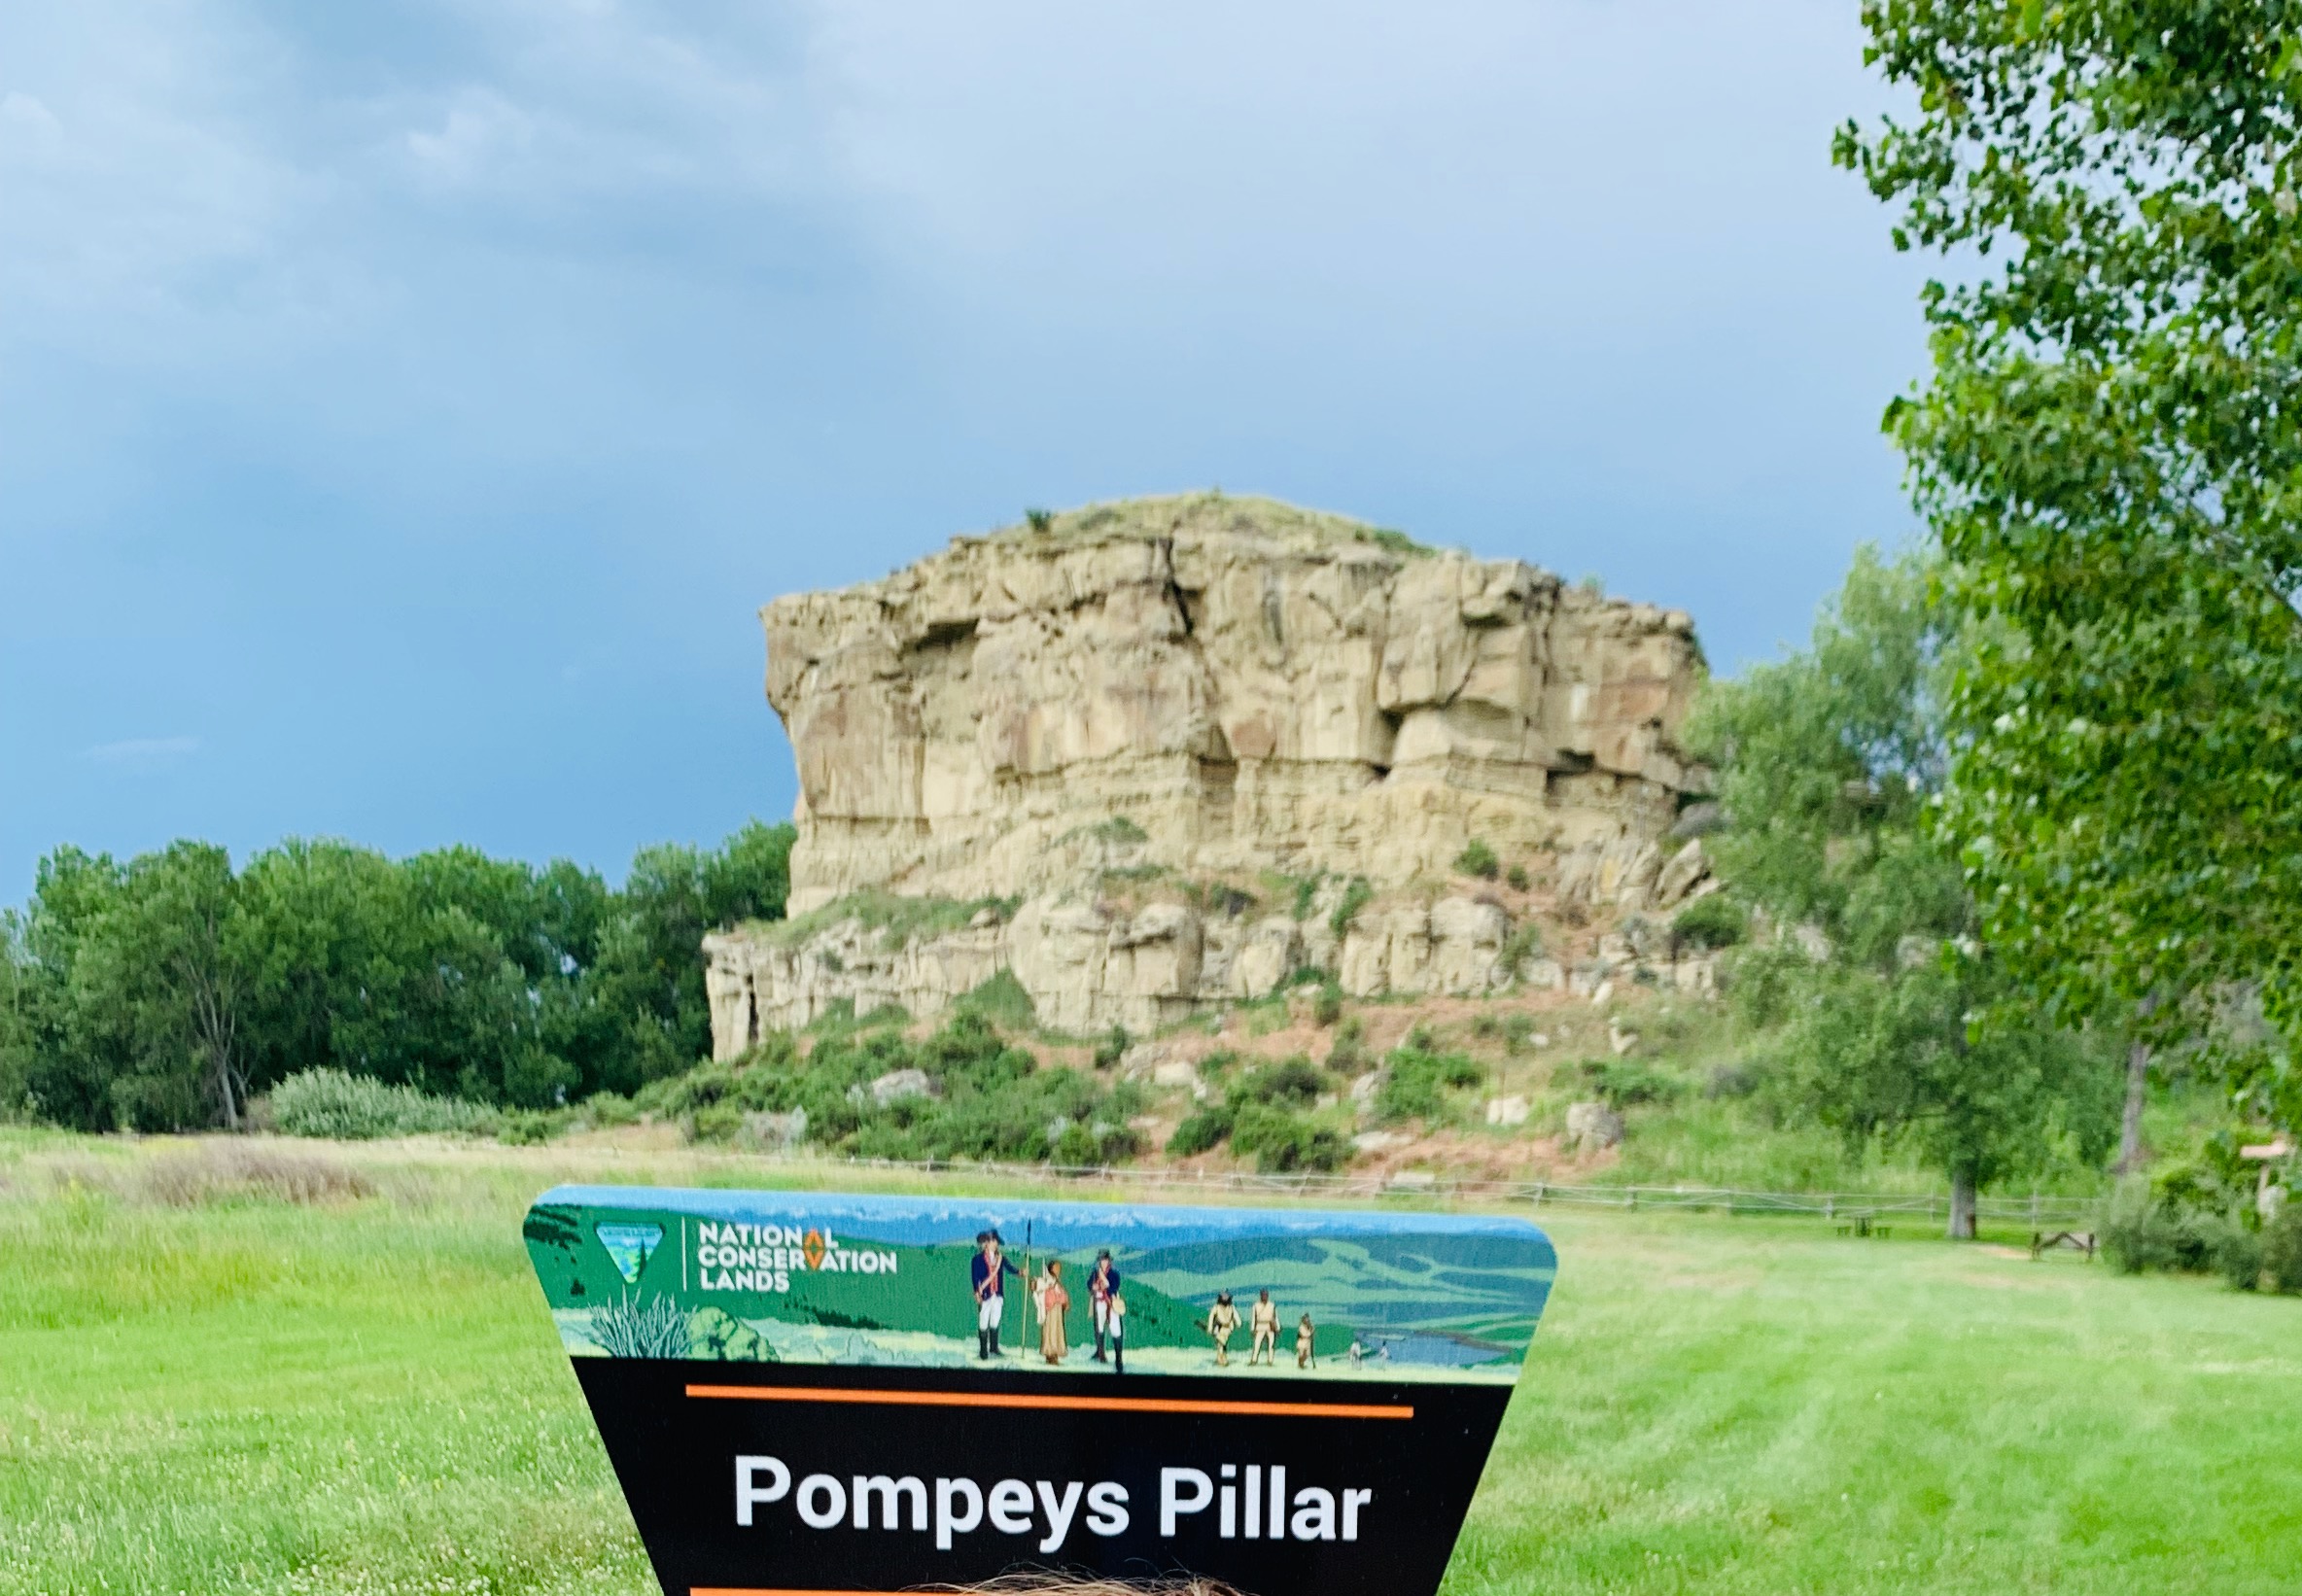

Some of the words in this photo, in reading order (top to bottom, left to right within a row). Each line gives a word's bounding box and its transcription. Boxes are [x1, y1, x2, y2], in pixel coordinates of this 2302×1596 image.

[698, 1222, 839, 1249] NATIONAL
[697, 1244, 897, 1274] CONSERVATION
[699, 1267, 790, 1293] LANDS
[733, 1454, 1131, 1553] Pompeys
[1159, 1464, 1374, 1542] Pillar
